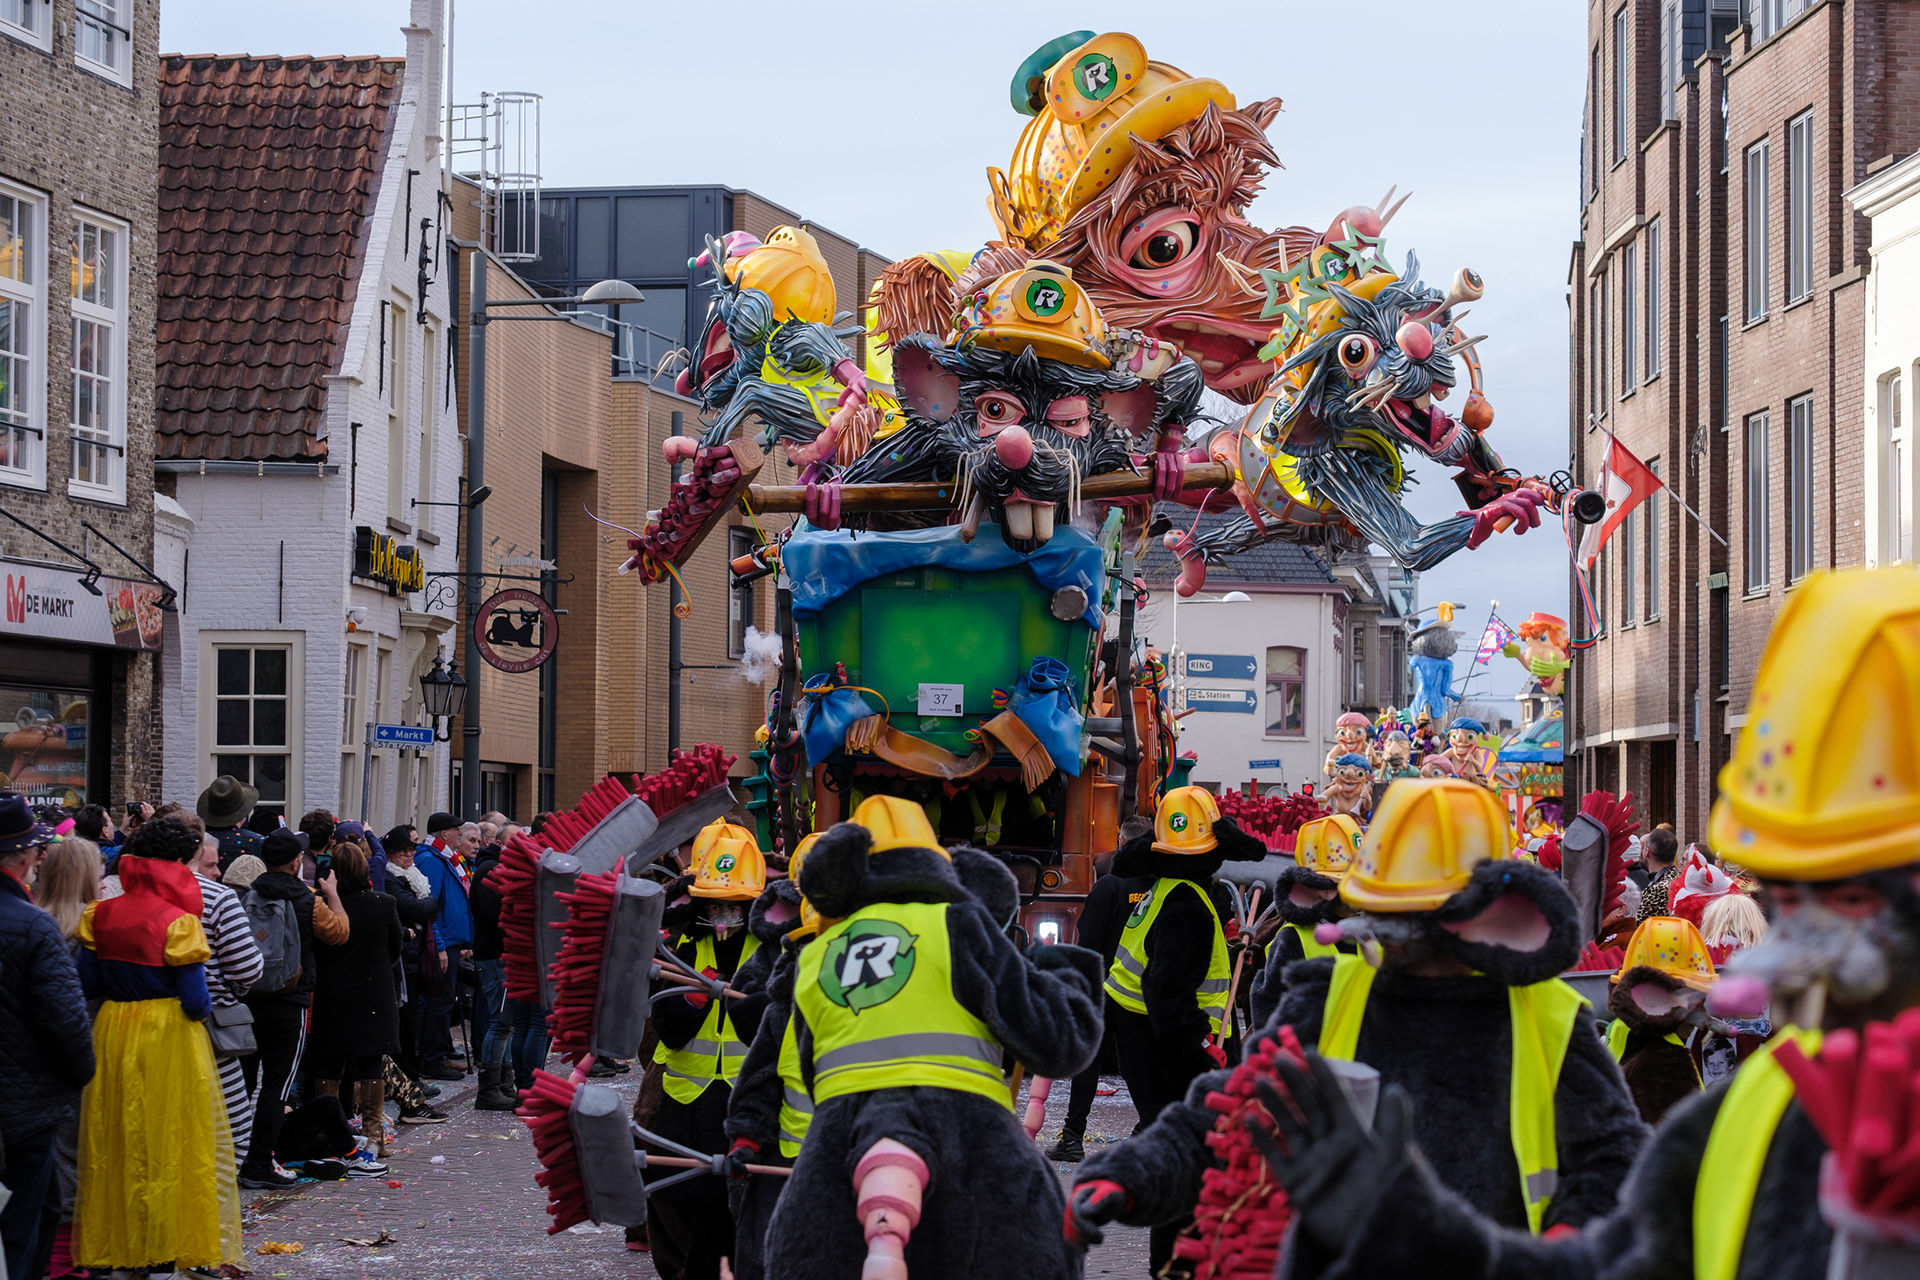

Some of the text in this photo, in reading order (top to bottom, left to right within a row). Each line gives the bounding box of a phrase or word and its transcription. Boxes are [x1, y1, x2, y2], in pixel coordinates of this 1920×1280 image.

[1085, 61, 1110, 92] R
[1327, 258, 1344, 276] R
[1035, 289, 1060, 307] R
[26, 594, 74, 618] DE MARKT
[488, 594, 506, 609] bar
[479, 642, 550, 672] de cleyne cat
[1190, 661, 1211, 670] RING
[933, 693, 949, 705] 37
[1206, 691, 1231, 699] Station
[395, 730, 424, 740] Markt
[840, 935, 900, 988] R
